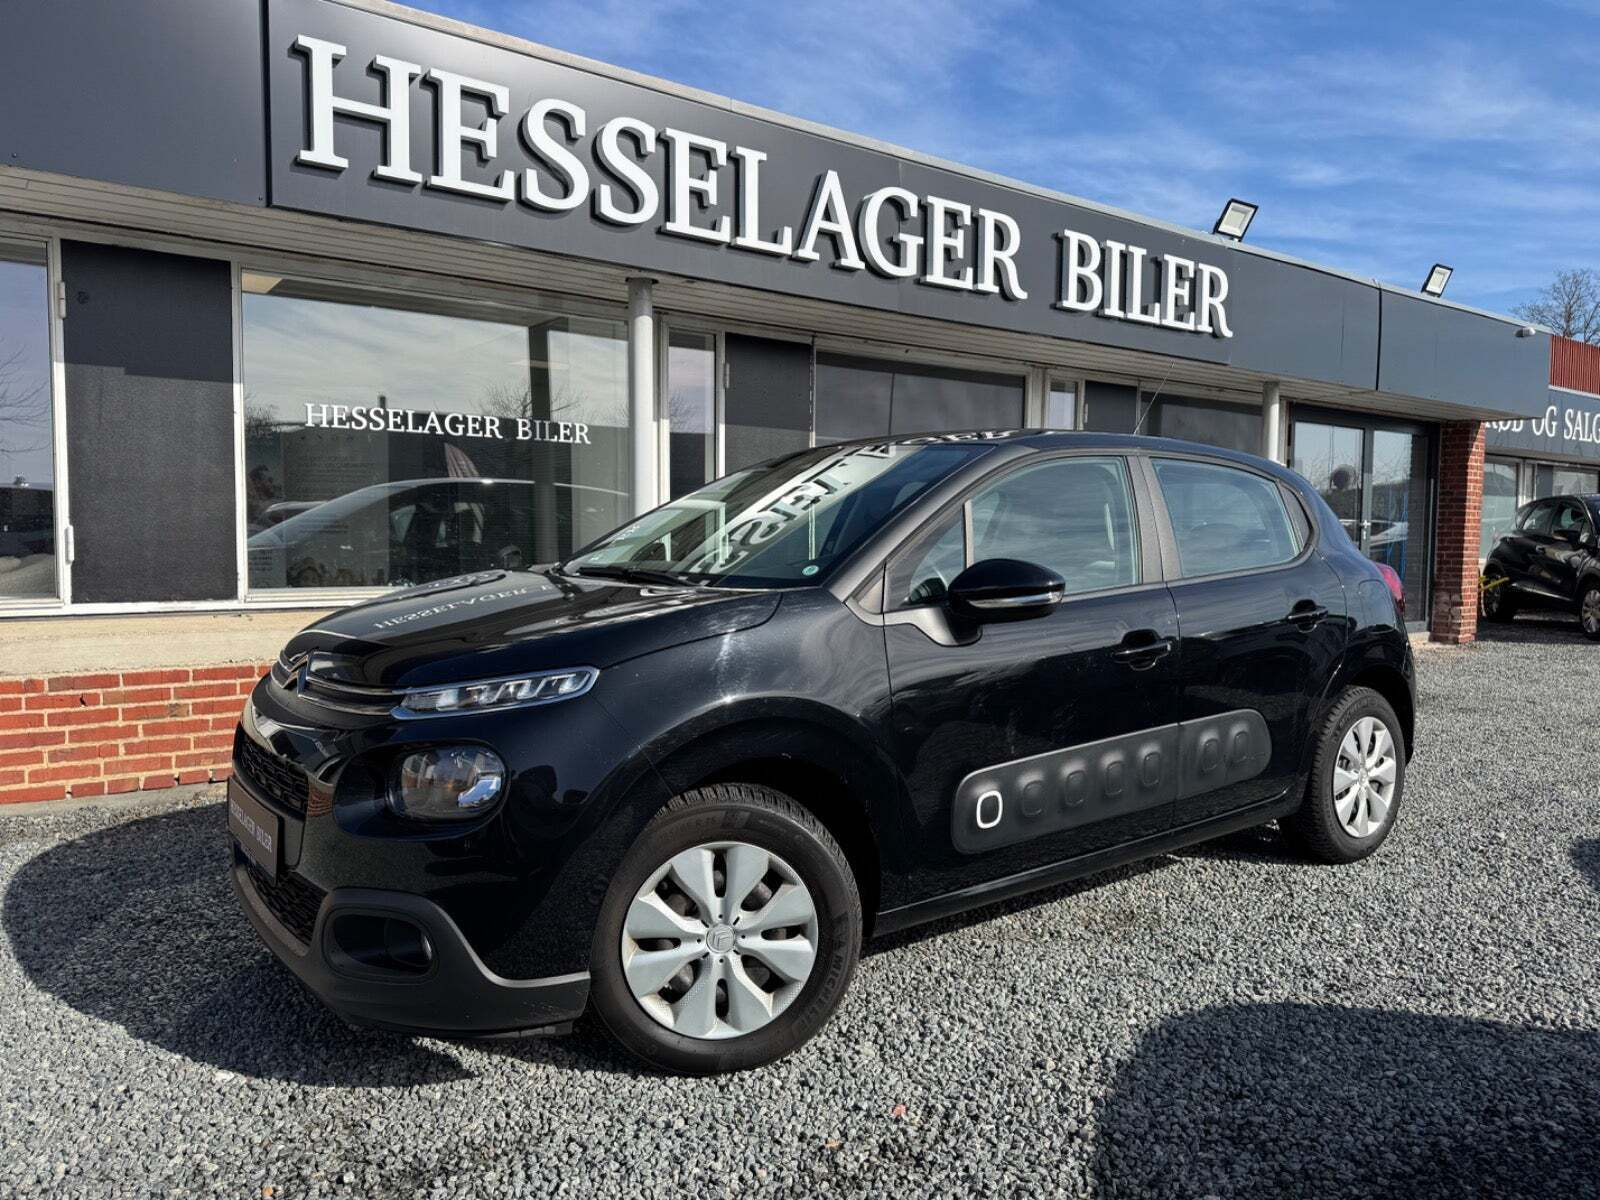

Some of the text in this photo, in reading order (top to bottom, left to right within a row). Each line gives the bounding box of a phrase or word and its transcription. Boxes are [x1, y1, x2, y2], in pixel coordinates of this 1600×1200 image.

[295, 35, 1234, 338] HESSELAGER BILER
[304, 402, 591, 444] HESSELAGER BILER
[1563, 408, 1600, 444] SALG
